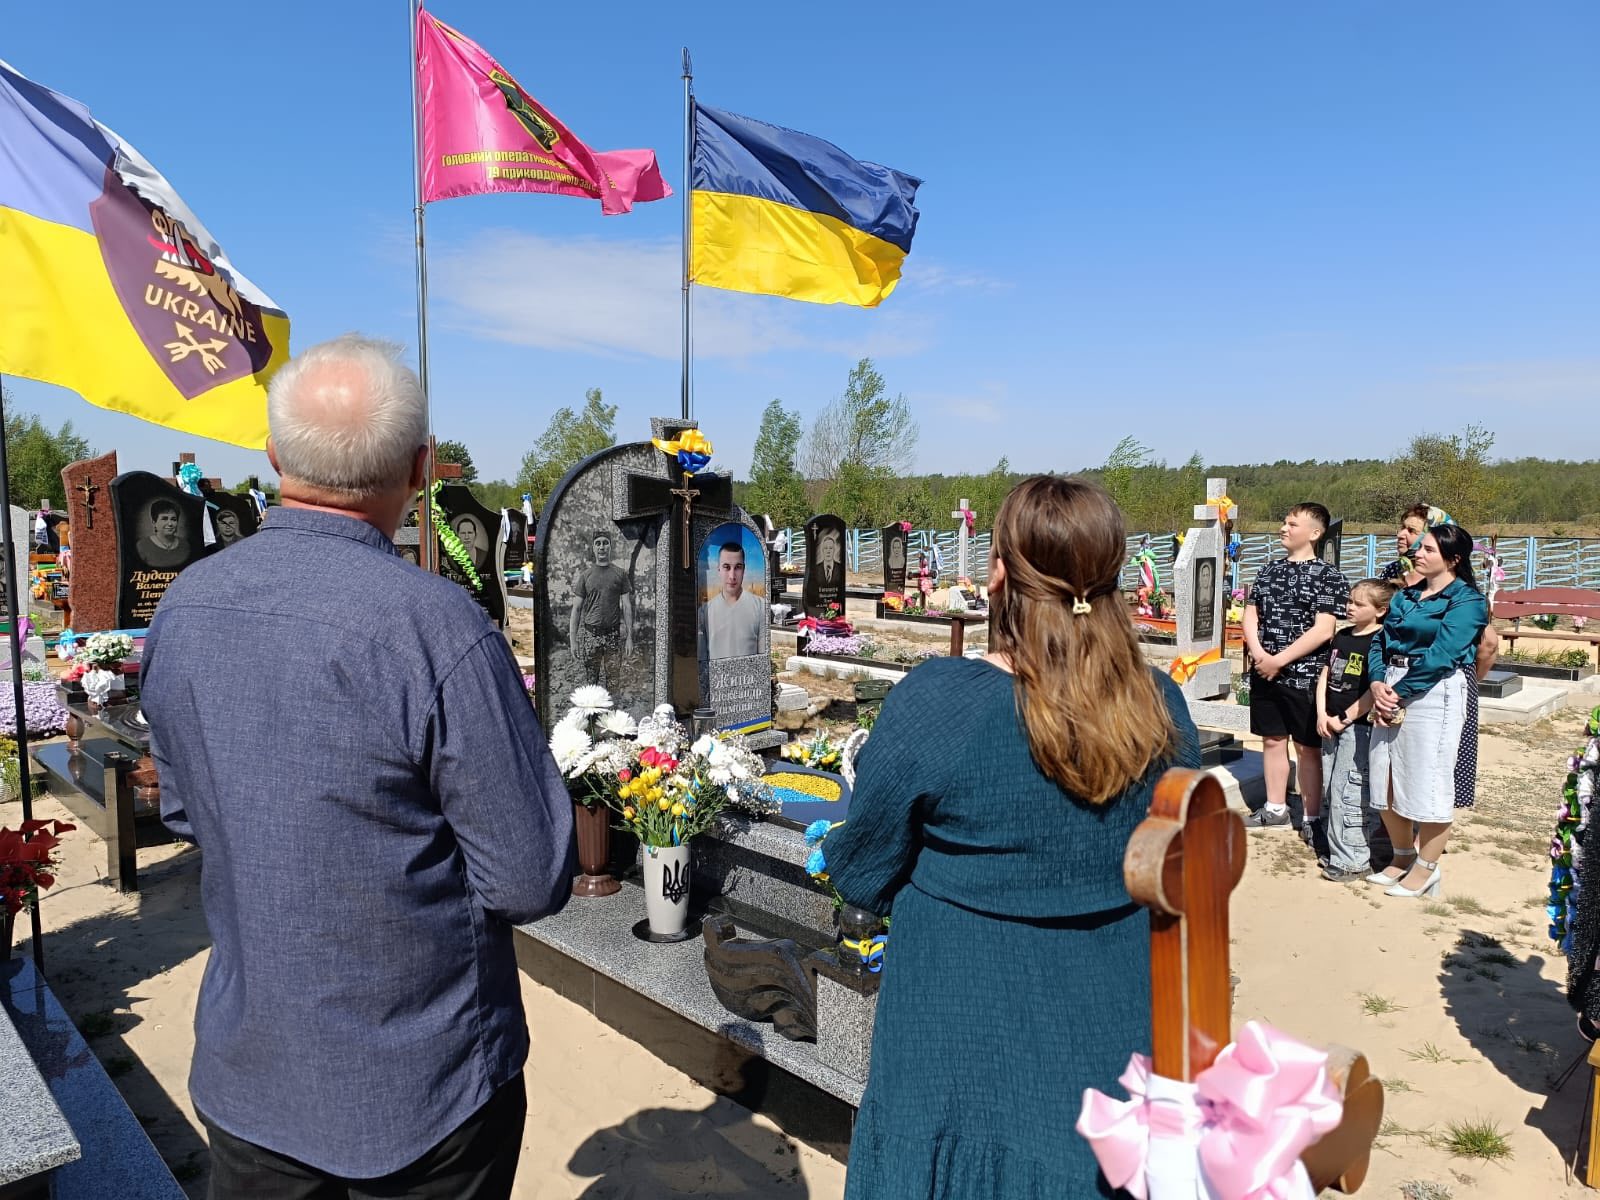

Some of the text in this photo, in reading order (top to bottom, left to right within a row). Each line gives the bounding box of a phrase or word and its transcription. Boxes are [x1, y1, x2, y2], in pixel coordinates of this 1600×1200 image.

[442, 151, 492, 167] Головний
[487, 166, 499, 179] 79
[145, 284, 257, 343] UKRAINE
